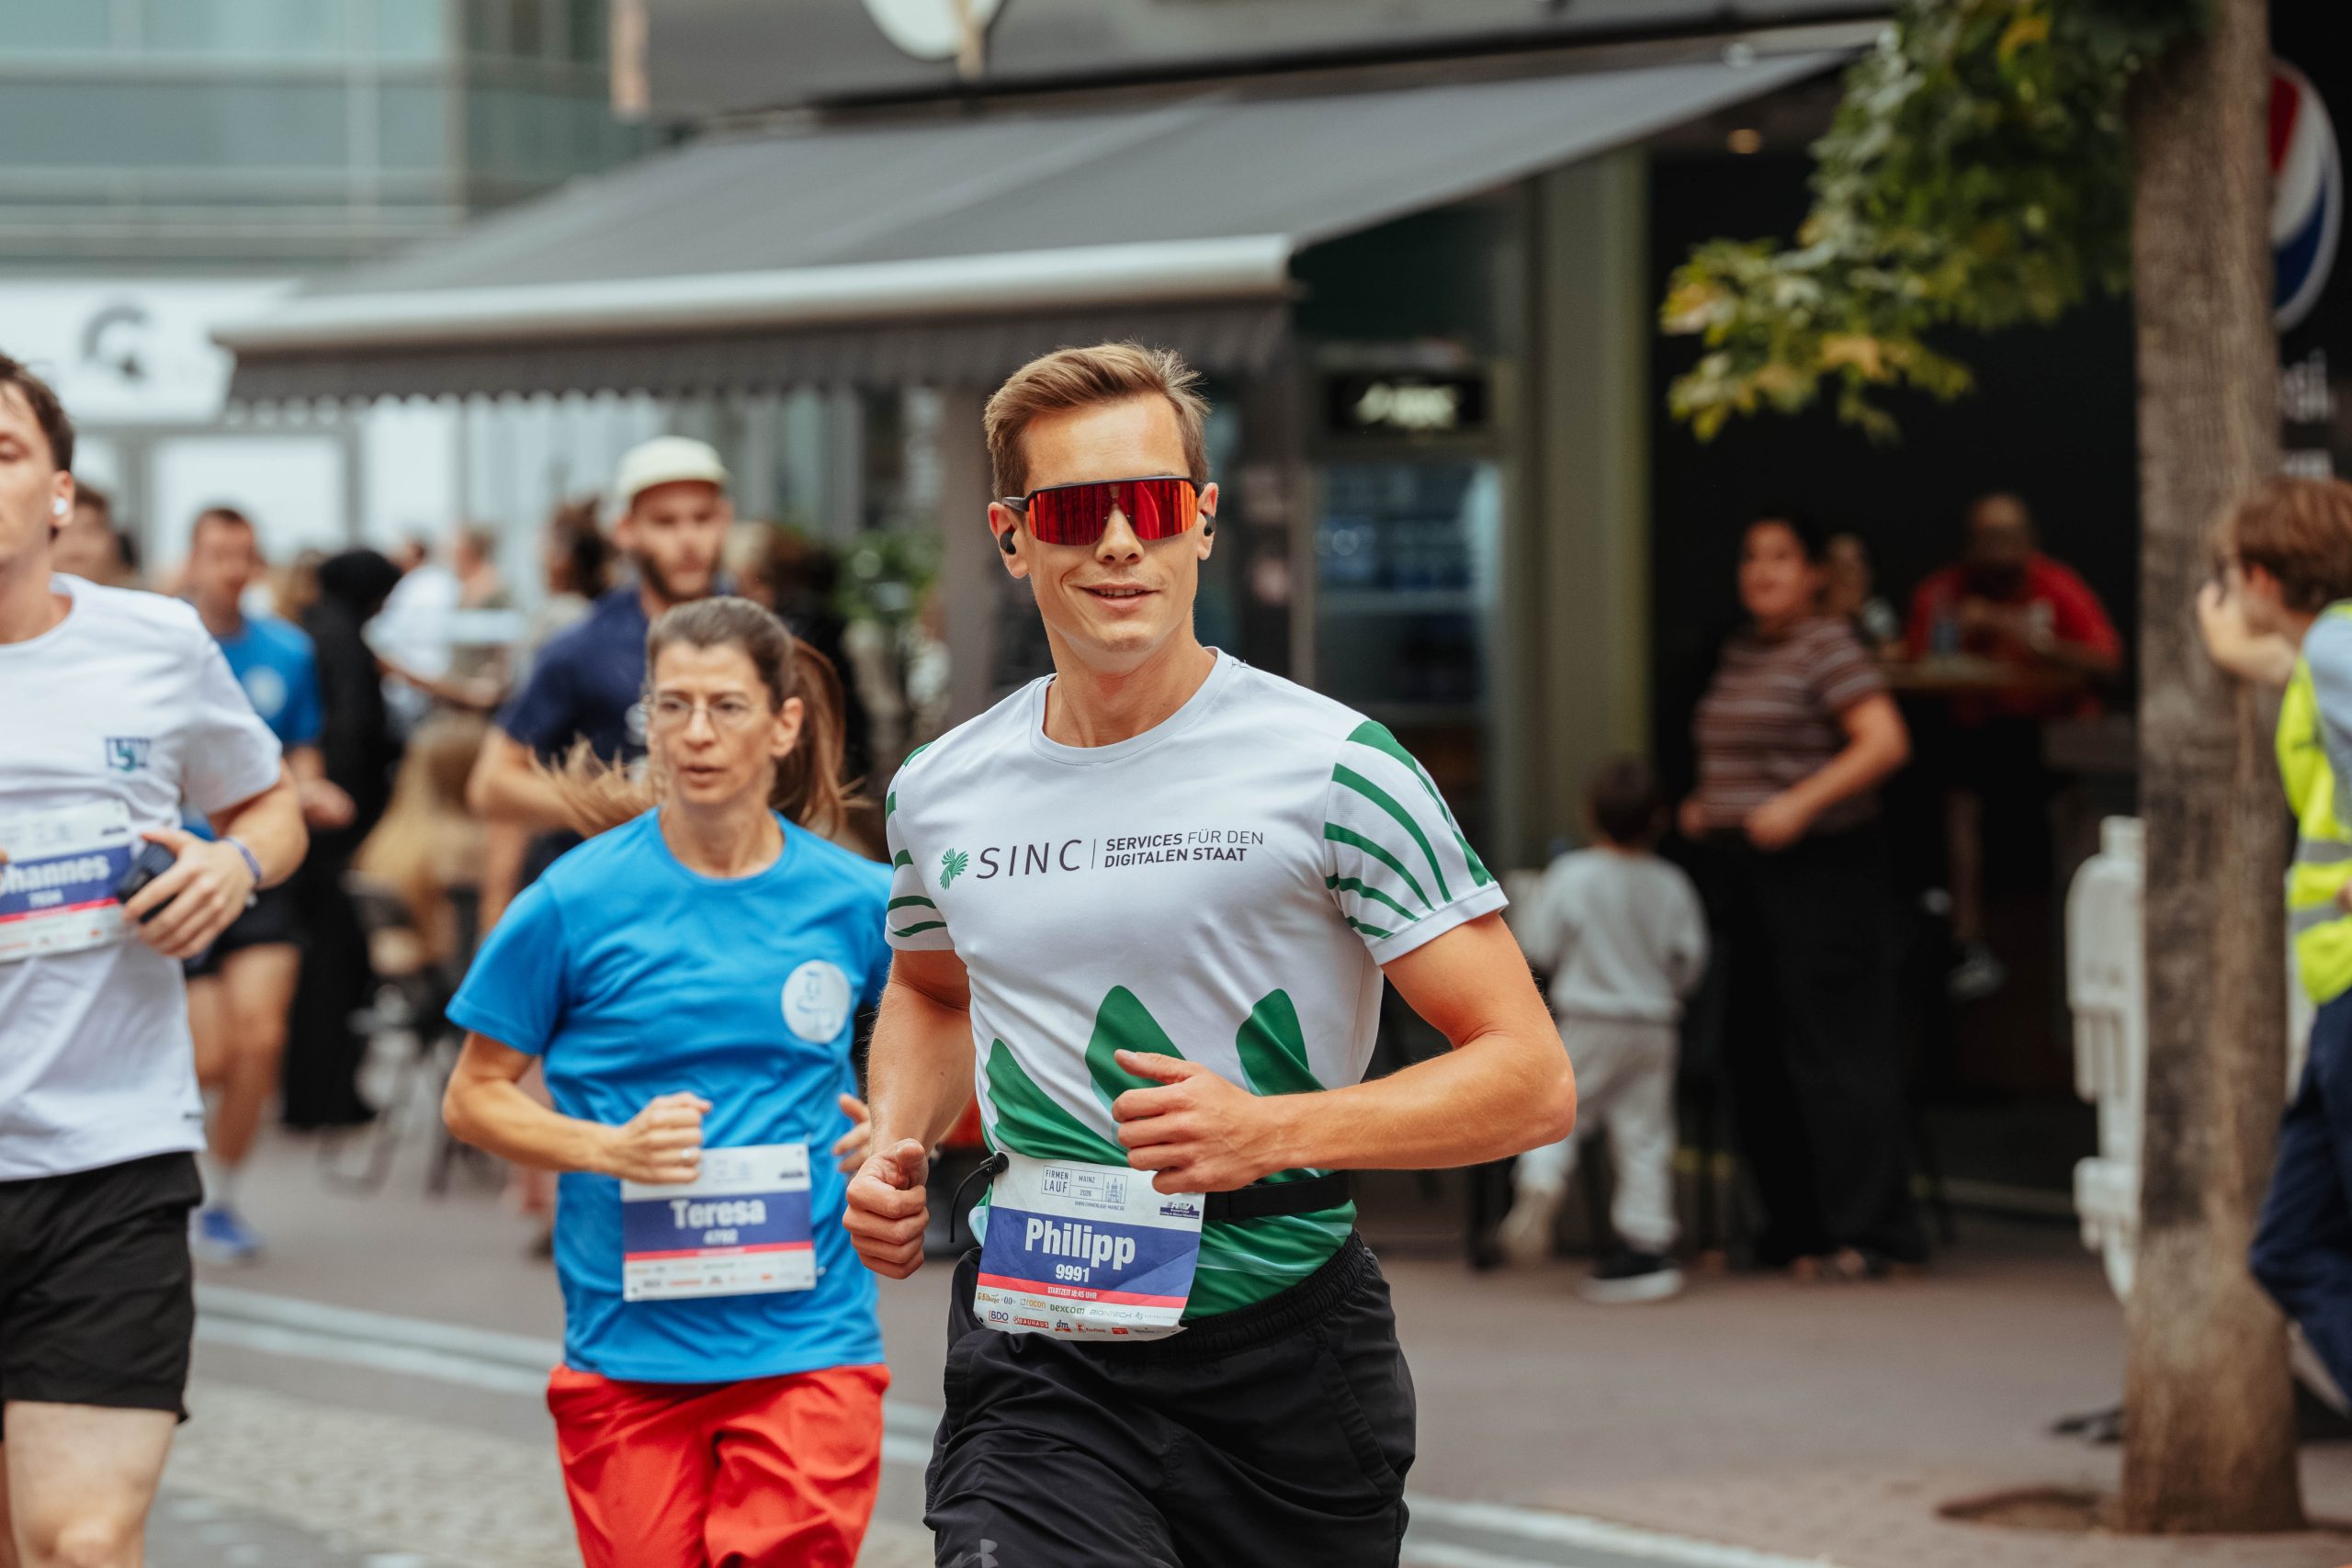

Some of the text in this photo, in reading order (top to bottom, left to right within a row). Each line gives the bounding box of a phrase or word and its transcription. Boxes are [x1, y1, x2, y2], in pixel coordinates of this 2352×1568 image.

[1105, 829, 1263, 852] SERVICES FÜR DEN
[976, 839, 1082, 880] SINC
[1104, 847, 1247, 868] DIGITALEN STAAT
[1046, 1169, 1069, 1179] FIRMEN
[1078, 1175, 1096, 1184] MAINZ
[1044, 1179, 1069, 1193] LAUF
[669, 1198, 767, 1230] Teresa
[1024, 1217, 1136, 1271] Philipp
[1055, 1263, 1091, 1283] 9991
[1047, 1286, 1071, 1297] STARTZEIT
[1085, 1291, 1098, 1300] UHR
[990, 1310, 1009, 1322] BDO
[1019, 1316, 1049, 1328] BAUHAUS
[1056, 1319, 1069, 1329] dm
